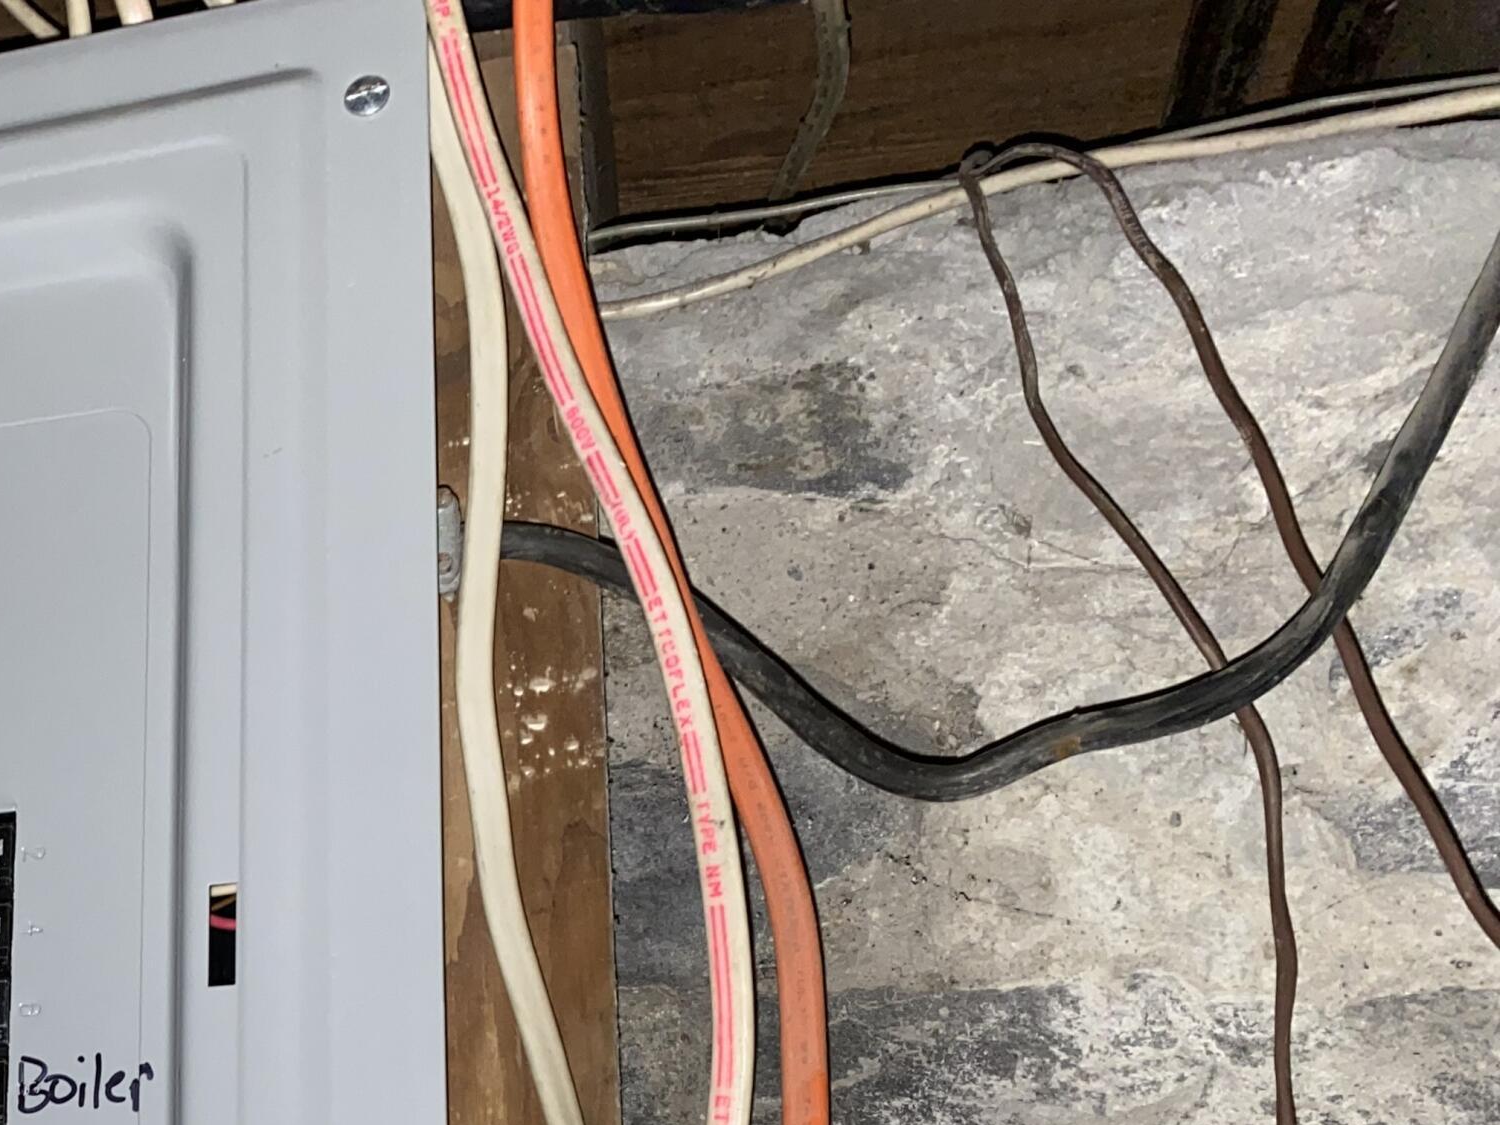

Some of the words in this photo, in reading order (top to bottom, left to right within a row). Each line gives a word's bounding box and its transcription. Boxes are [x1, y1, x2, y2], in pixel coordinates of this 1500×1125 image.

[487, 186, 516, 254] 14/2WG
[566, 406, 596, 450] 600V
[696, 801, 718, 855] TYPE
[705, 864, 724, 899] NM
[18, 1052, 154, 1113] Boiler
